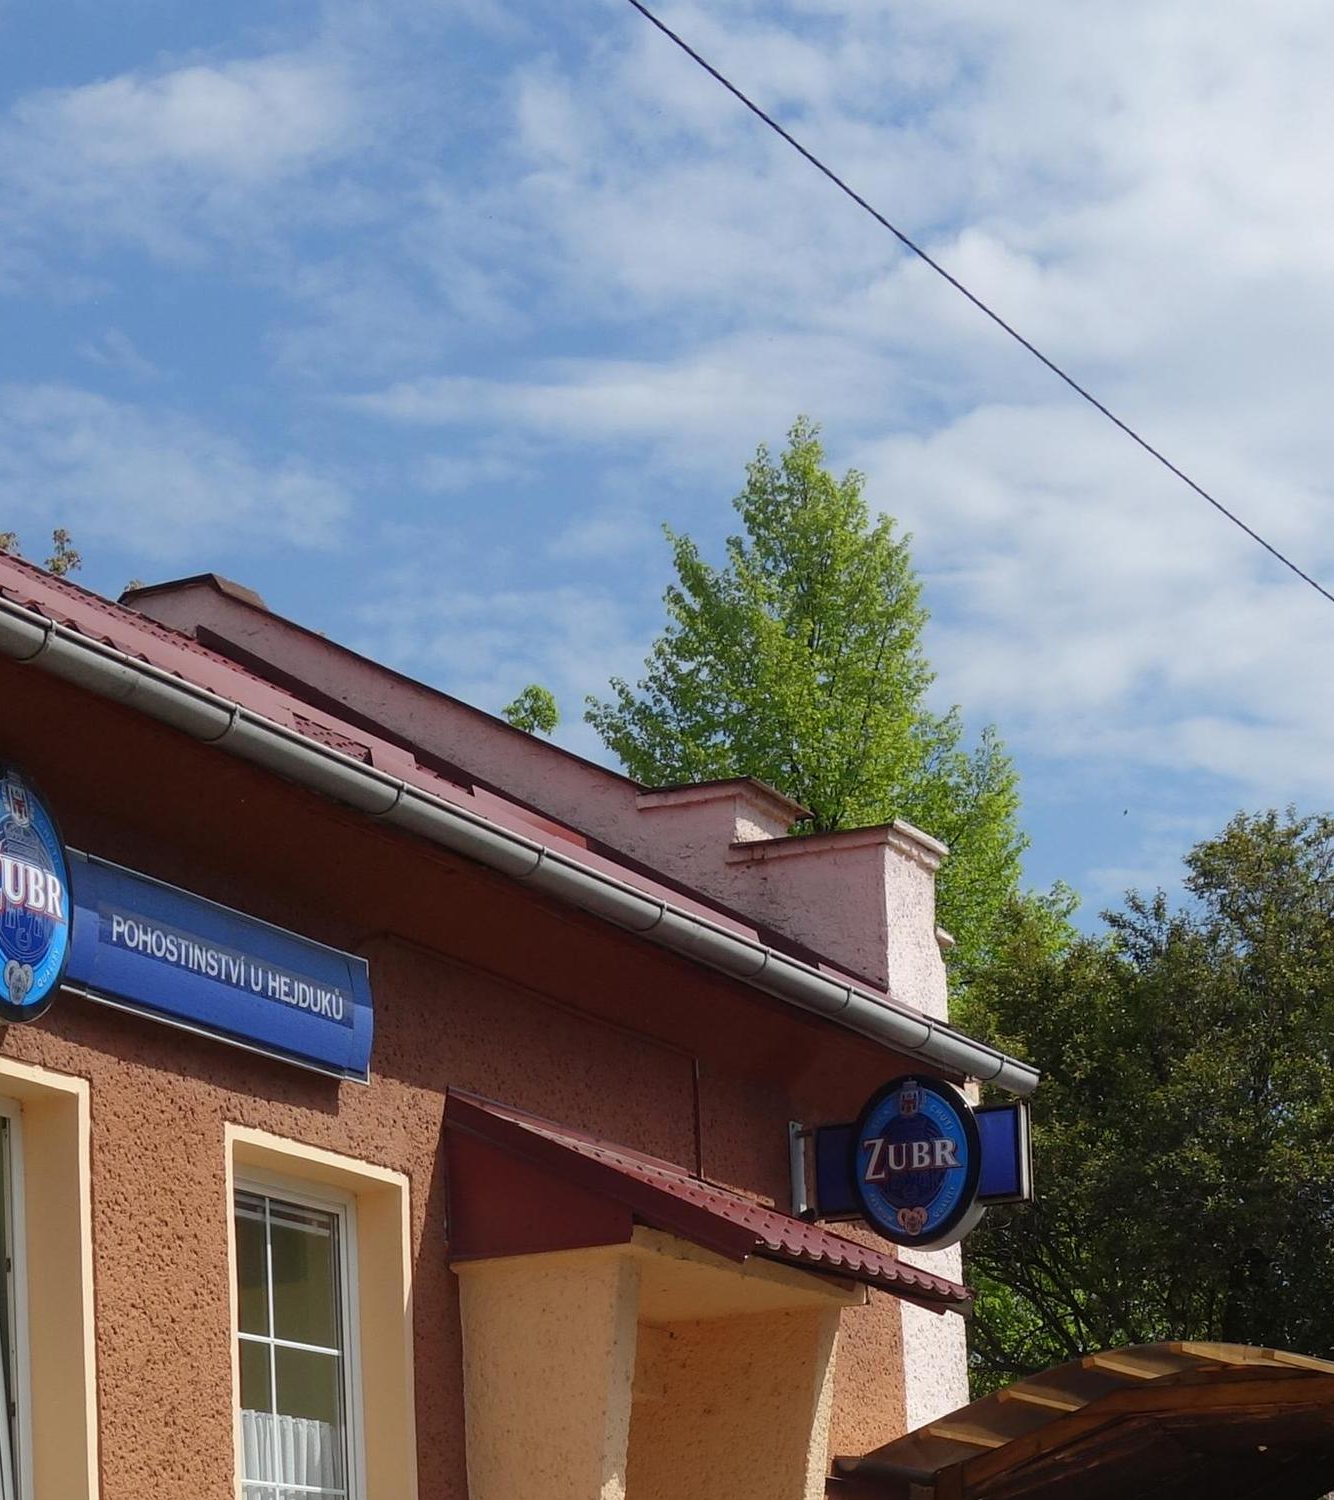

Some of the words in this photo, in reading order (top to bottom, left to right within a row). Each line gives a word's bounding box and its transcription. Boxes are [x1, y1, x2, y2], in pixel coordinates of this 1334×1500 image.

[112, 914, 245, 987] POHOSTINSTVÍ
[250, 966, 263, 992] U
[267, 969, 344, 1020] HEJDUKŮ
[863, 1137, 964, 1183] ZUBR
